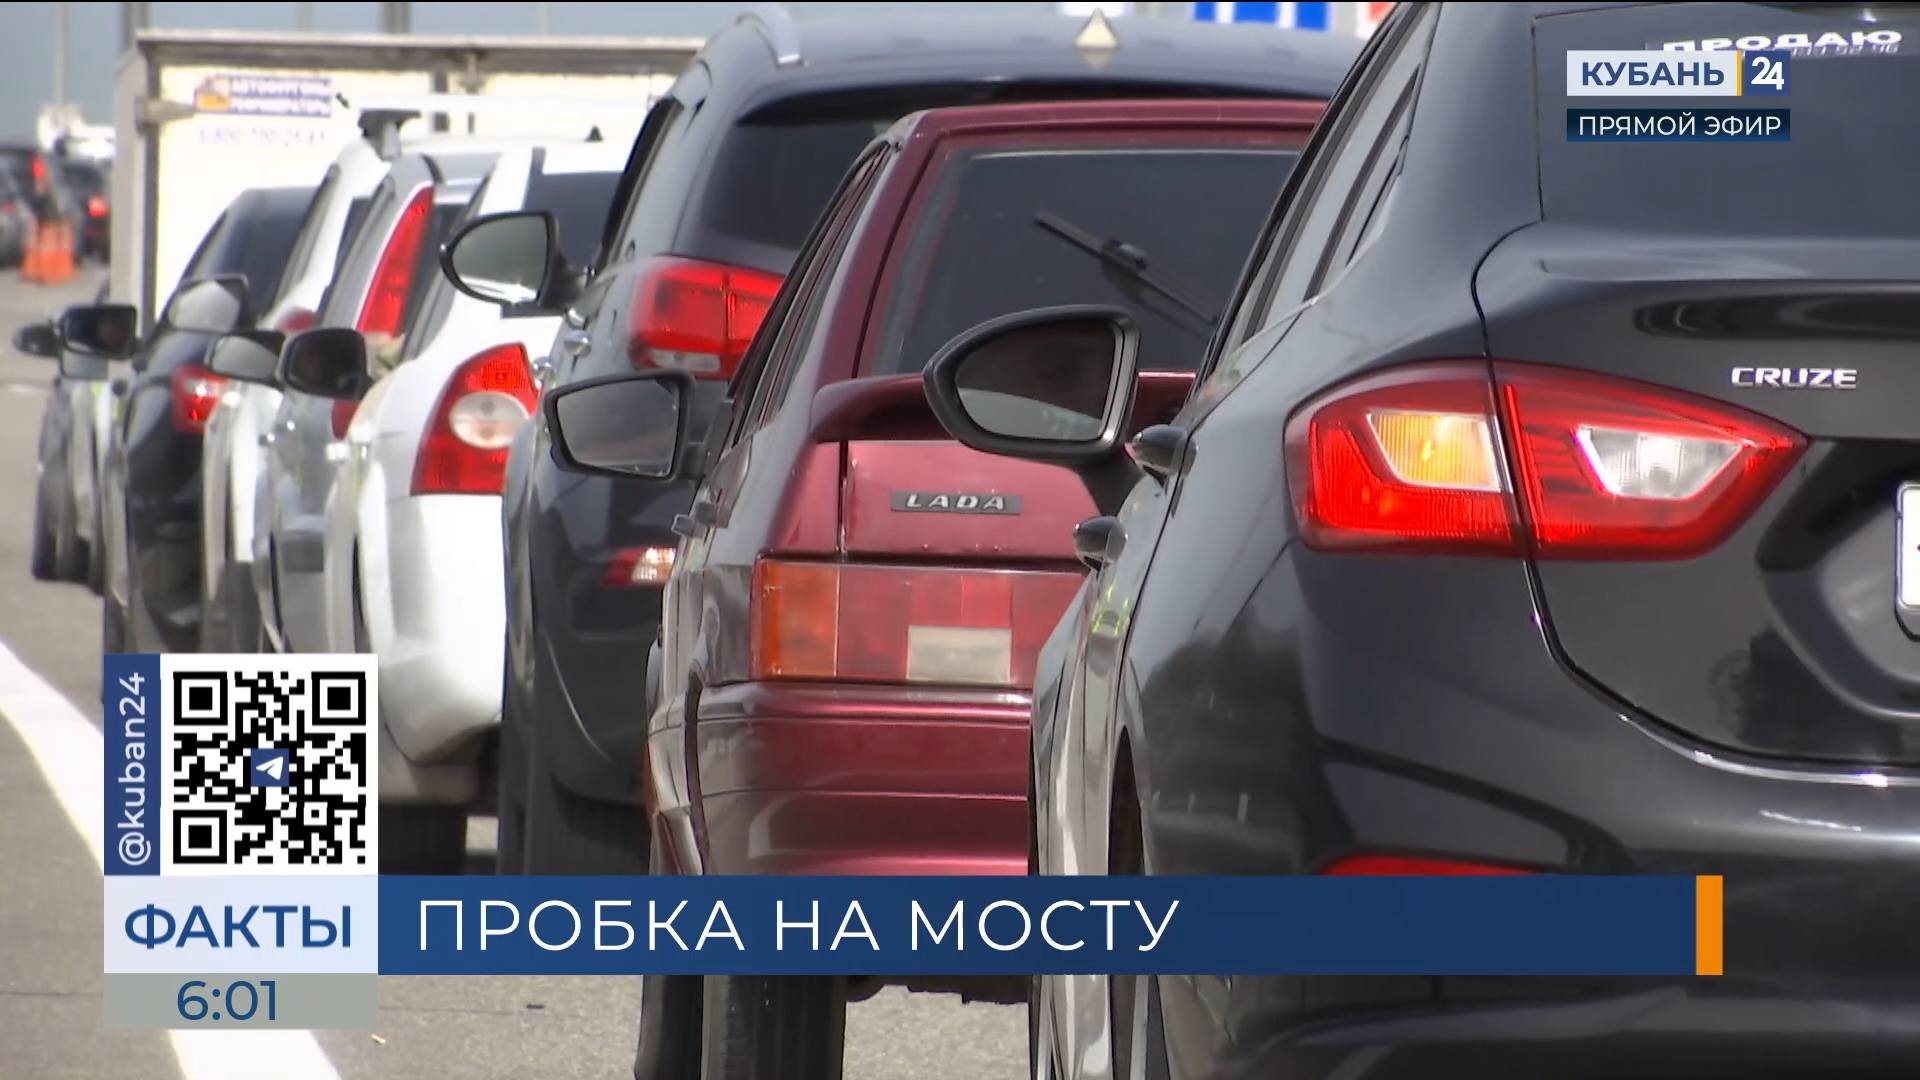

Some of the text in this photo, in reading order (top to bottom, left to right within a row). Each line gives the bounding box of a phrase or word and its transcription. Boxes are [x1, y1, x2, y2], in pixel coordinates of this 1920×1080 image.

[1663, 30, 1902, 51] ПРОДАЮ
[1731, 367, 1858, 390] CRUZE
[906, 493, 1005, 511] LADA
